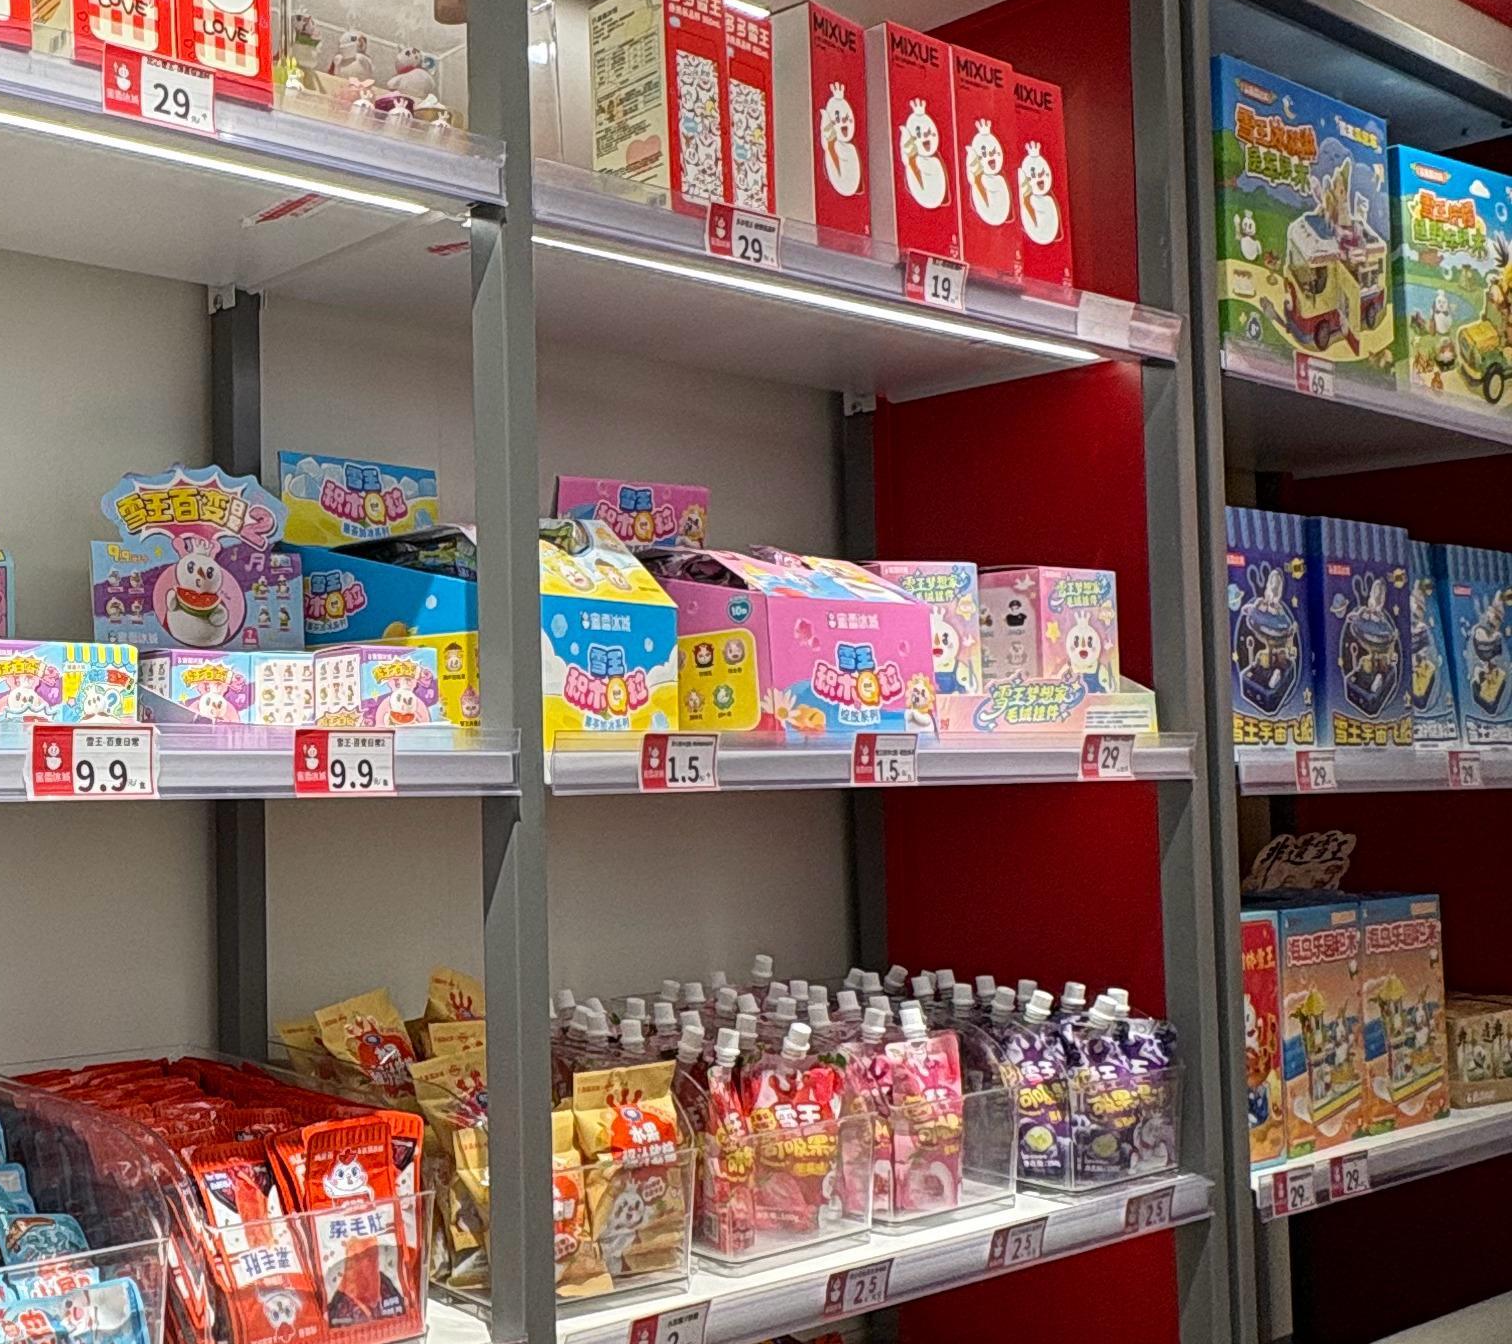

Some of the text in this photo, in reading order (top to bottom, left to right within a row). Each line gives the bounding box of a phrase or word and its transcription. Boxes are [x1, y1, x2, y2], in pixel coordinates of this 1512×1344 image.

[813, 10, 857, 53] MIXUE
[891, 31, 940, 69] MIXUE
[956, 54, 1004, 89] MIXUE
[153, 82, 191, 119] 29
[738, 234, 764, 263] 29
[931, 274, 952, 302] 19
[1310, 373, 1326, 396] 69
[346, 464, 381, 492] 雪王
[619, 485, 653, 512] 雪王
[589, 646, 626, 678] 雪王
[838, 643, 876, 672] 雪王
[668, 755, 700, 783] 1.5
[876, 758, 900, 782] 1.5
[1101, 745, 1120, 770] 29
[76, 759, 128, 792] 9.9
[330, 758, 374, 789] 9.9
[1311, 765, 1327, 787] 29
[1461, 764, 1474, 787] 29
[774, 1103, 822, 1129] 雪王
[1345, 1169, 1361, 1193] 29
[1290, 1185, 1306, 1208] 29
[328, 1212, 387, 1239] 素毛肚
